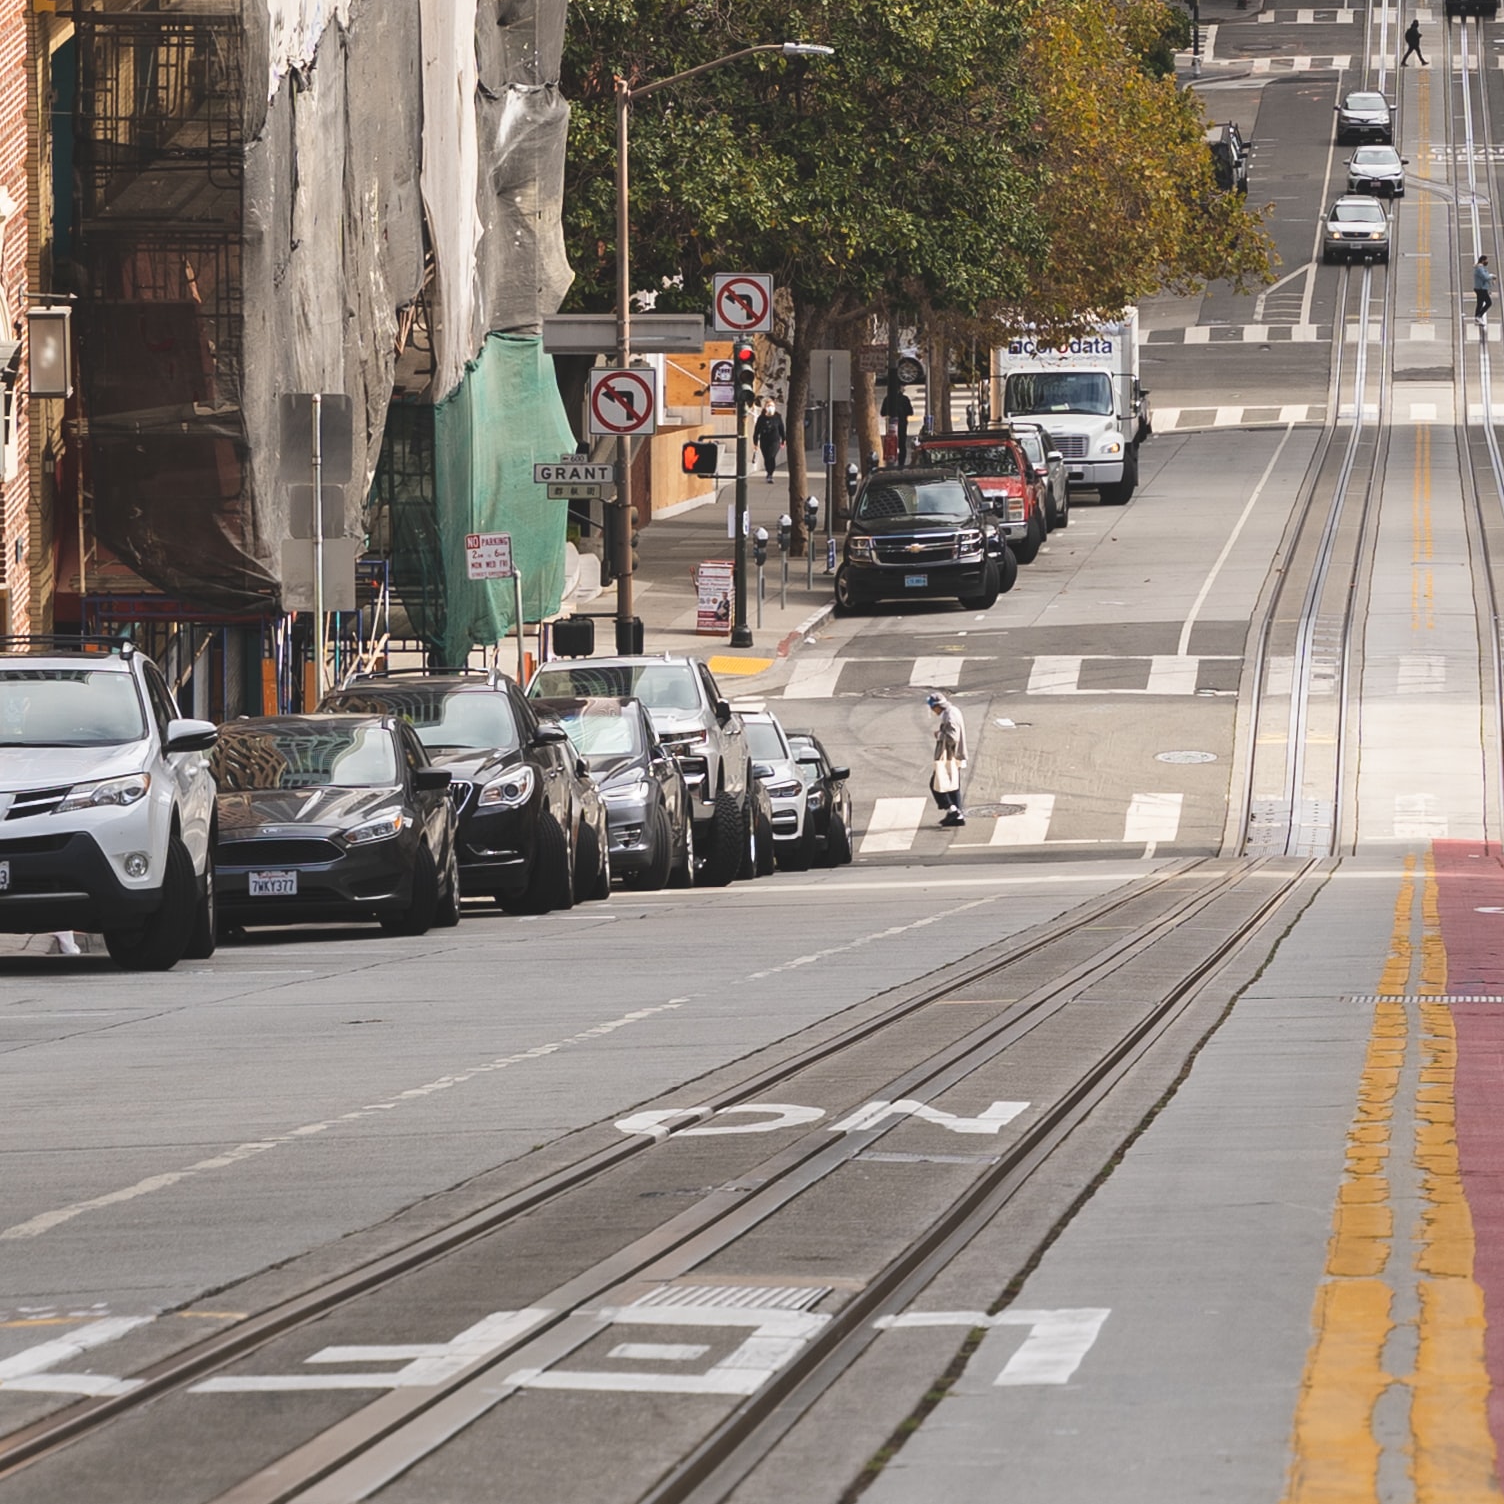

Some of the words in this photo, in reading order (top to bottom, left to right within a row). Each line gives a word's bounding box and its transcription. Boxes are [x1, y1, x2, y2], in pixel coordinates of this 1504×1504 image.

[541, 467, 608, 479] GRANT
[467, 536, 479, 548] NO
[252, 879, 294, 893] 7WKY377
